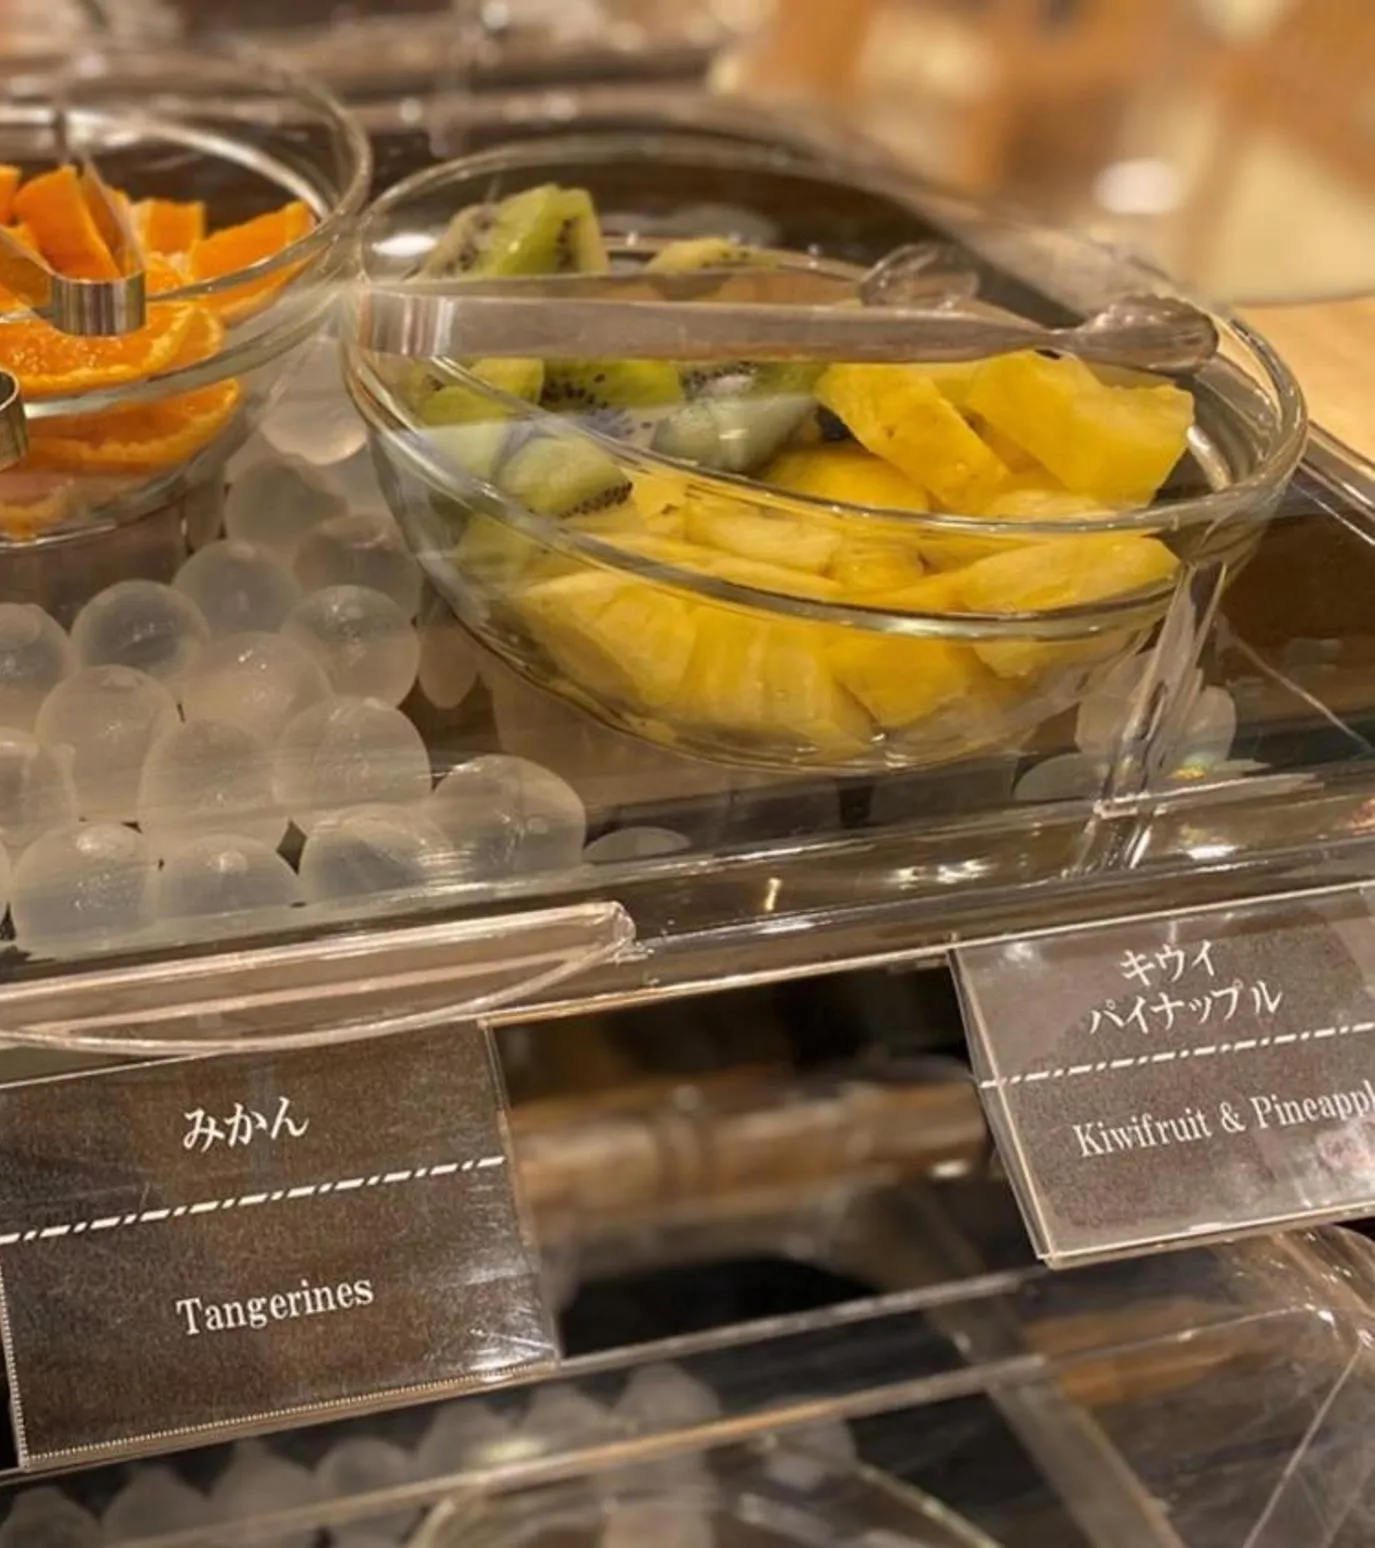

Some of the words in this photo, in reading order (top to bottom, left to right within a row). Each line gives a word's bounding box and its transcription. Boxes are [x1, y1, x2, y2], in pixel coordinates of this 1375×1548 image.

[1119, 939, 1216, 987] キウイ
[1088, 979, 1284, 1035] パイナップル
[182, 1096, 310, 1153] みかん
[1073, 1107, 1213, 1158] Kiwifruit
[1220, 1101, 1246, 1134] &
[175, 1278, 374, 1336] Tangerines
